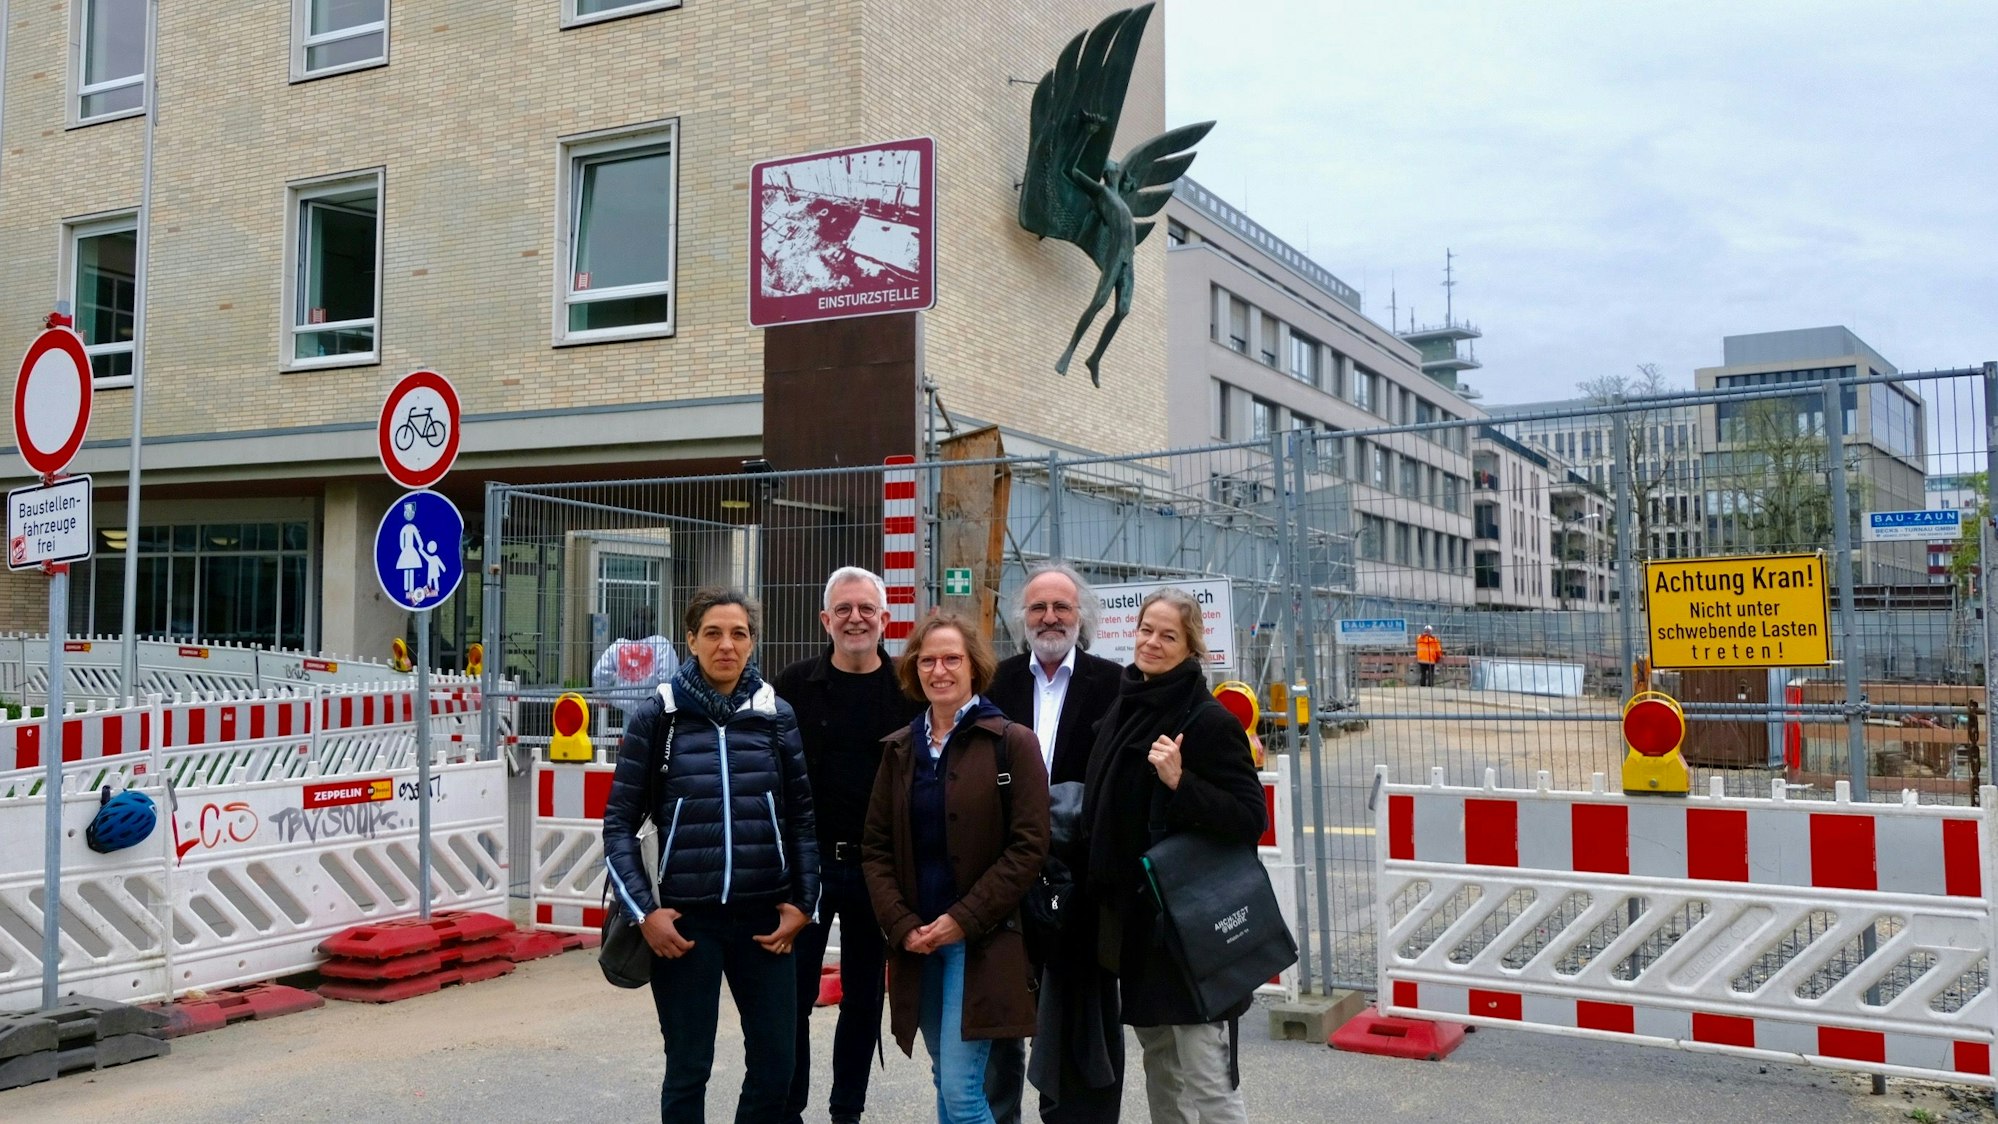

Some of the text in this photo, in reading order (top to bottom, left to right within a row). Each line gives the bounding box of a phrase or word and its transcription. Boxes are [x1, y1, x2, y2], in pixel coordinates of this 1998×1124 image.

[818, 287, 920, 309] EINSTURZSTELLE
[19, 495, 81, 519] Baustellen-
[23, 517, 76, 537] fahrzeuge
[37, 535, 56, 554] frei
[1655, 564, 1814, 596] Achtung Kran!
[1690, 601, 1780, 619] Nicht unter
[1096, 629, 1121, 640] Eltern
[1658, 620, 1818, 641] schwebende Lasten
[313, 787, 363, 802] ZEPPELIN
